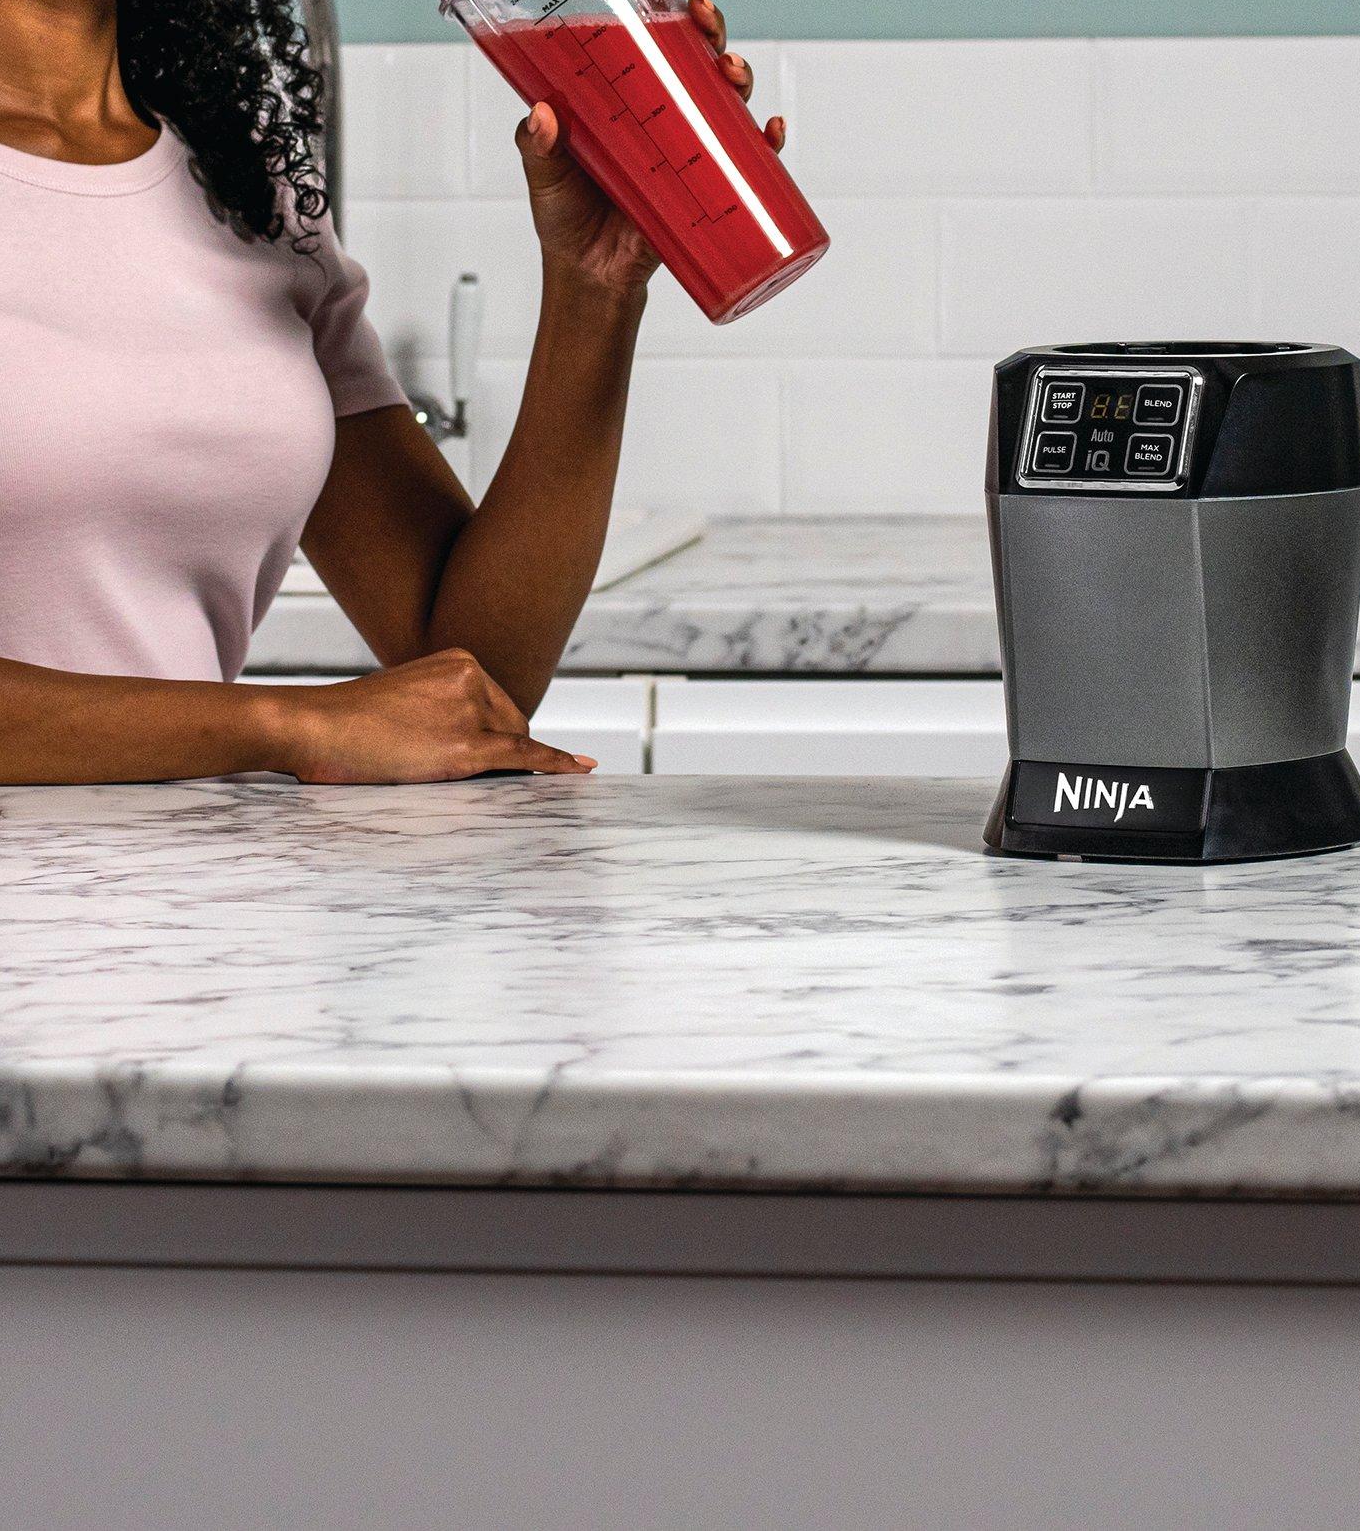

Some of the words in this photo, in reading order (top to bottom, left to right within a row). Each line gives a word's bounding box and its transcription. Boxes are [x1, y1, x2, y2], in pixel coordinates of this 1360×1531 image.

[622, 63, 635, 76] 400
[651, 104, 666, 118] 300
[687, 152, 702, 166] 200
[724, 204, 738, 216] 100
[1052, 392, 1076, 400] START
[1144, 399, 1173, 408] BLEND
[1091, 428, 1114, 443] Auto
[1043, 446, 1066, 454] PULSE
[1140, 444, 1160, 452] MAX
[1085, 450, 1110, 472] iQ
[1134, 452, 1163, 462] BLEND
